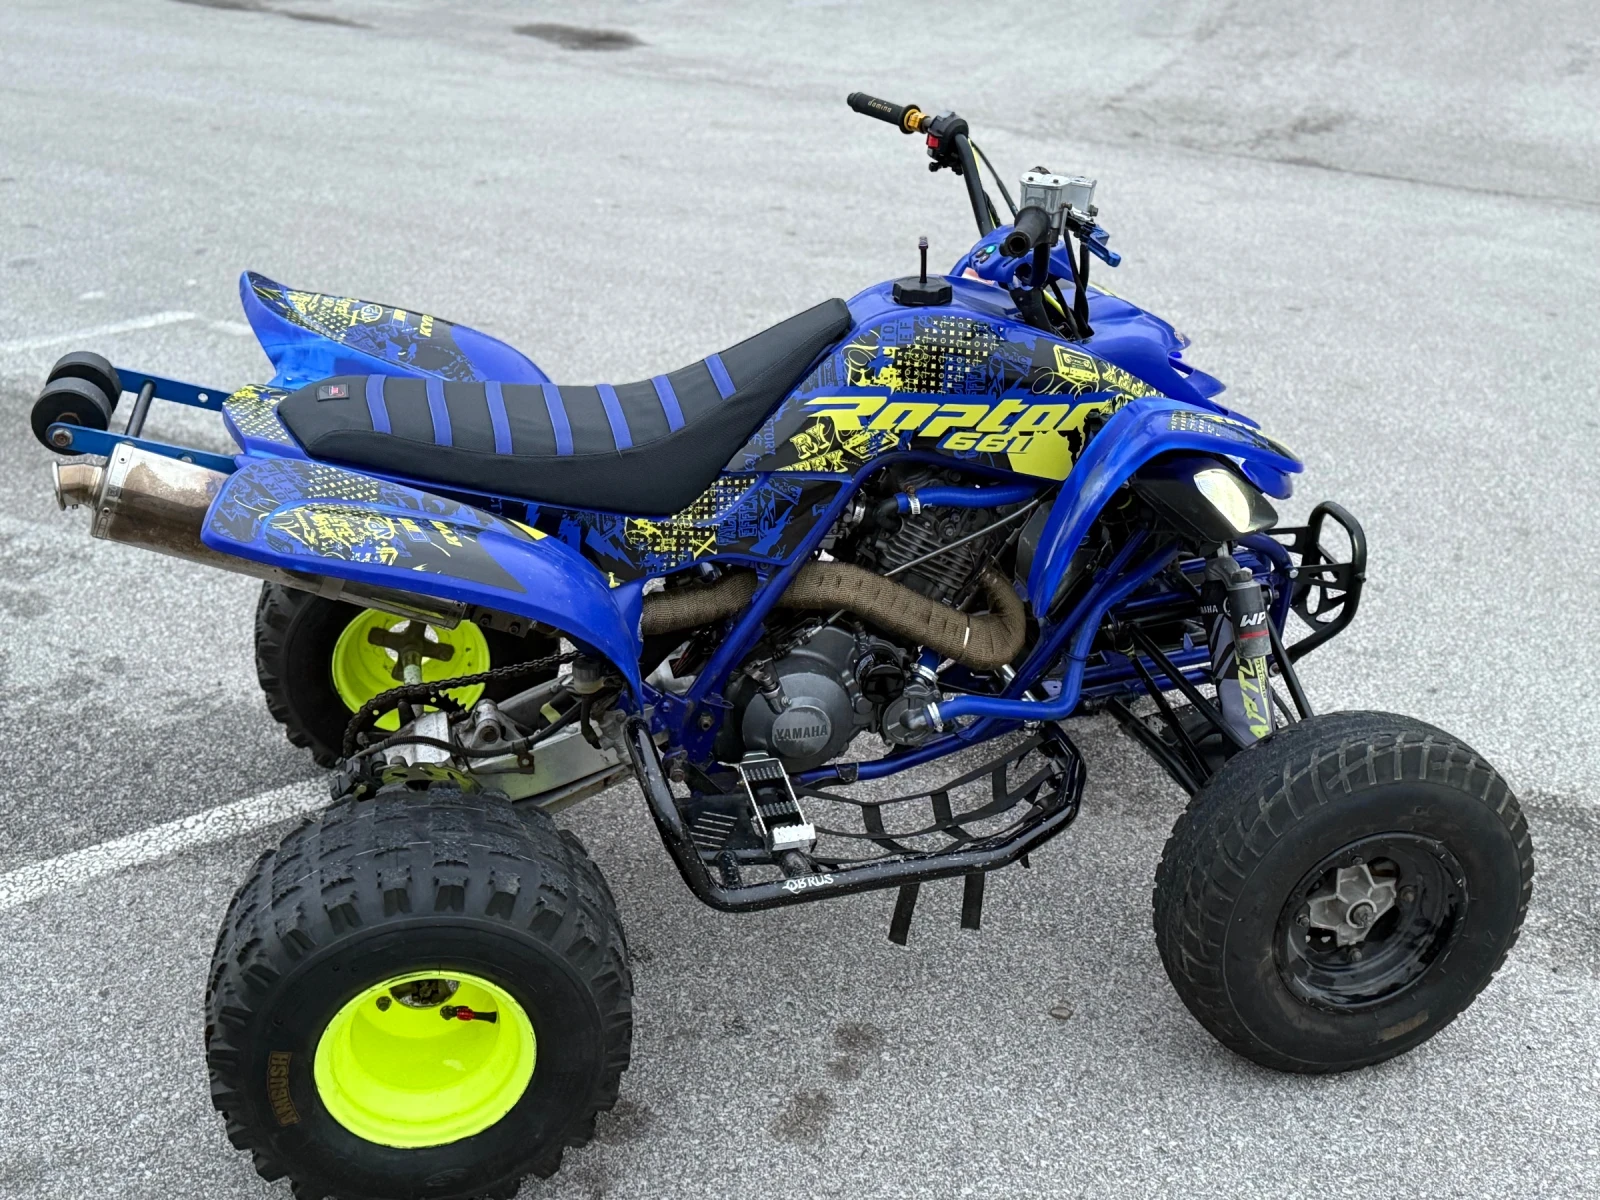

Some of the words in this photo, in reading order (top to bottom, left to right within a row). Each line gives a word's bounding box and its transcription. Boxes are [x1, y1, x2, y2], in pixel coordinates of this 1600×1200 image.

[804, 396, 1110, 437] Raptor
[1239, 611, 1266, 628] WP
[775, 724, 828, 741] YAMAHA
[268, 1052, 300, 1126] AMBUSH
